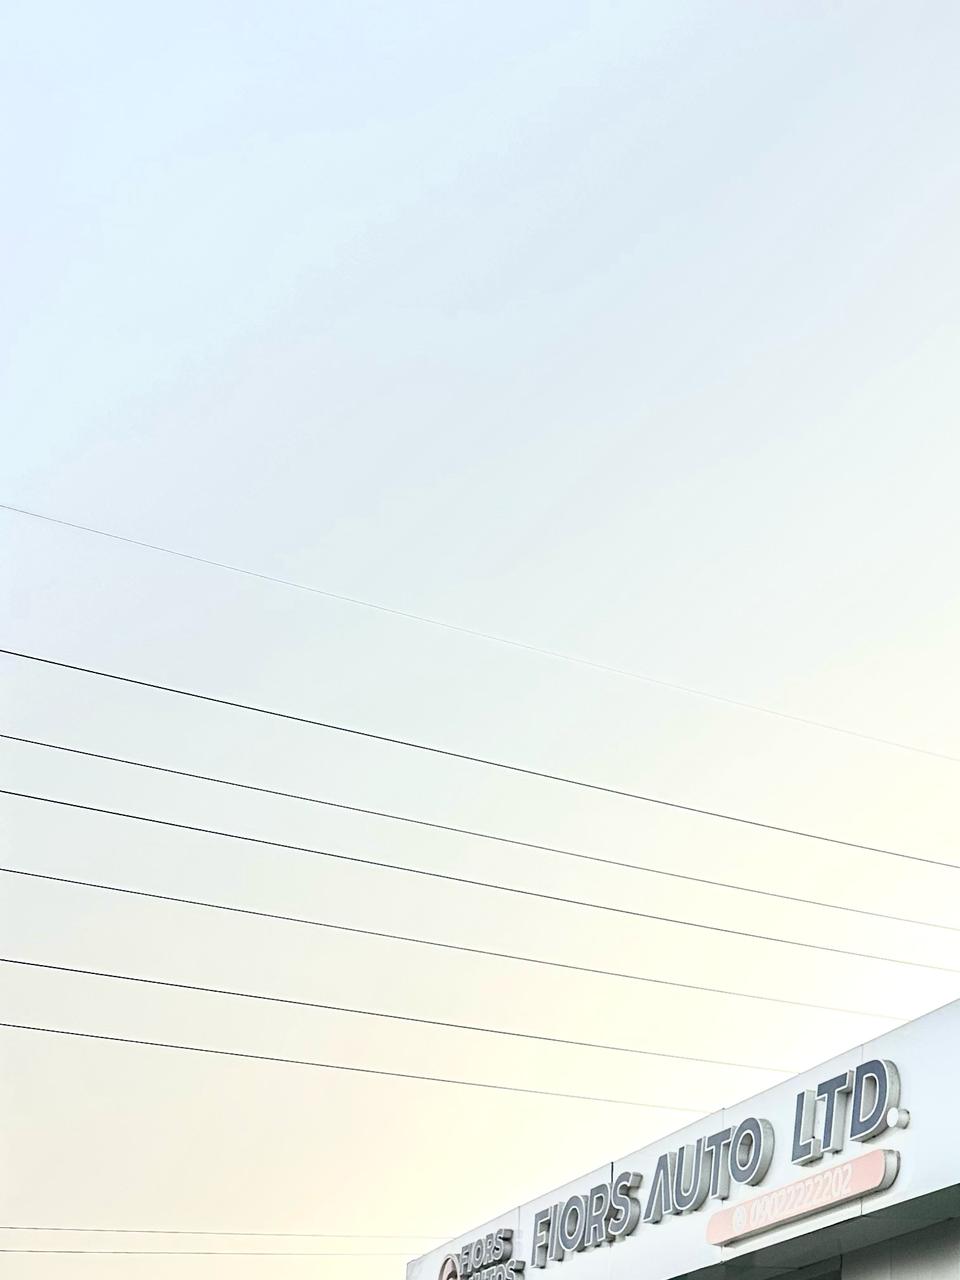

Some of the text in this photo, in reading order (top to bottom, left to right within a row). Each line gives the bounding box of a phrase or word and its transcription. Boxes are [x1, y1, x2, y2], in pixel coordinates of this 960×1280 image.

[531, 1059, 906, 1267] FIORS AUTO LTD.
[460, 1229, 511, 1275] FIORS
